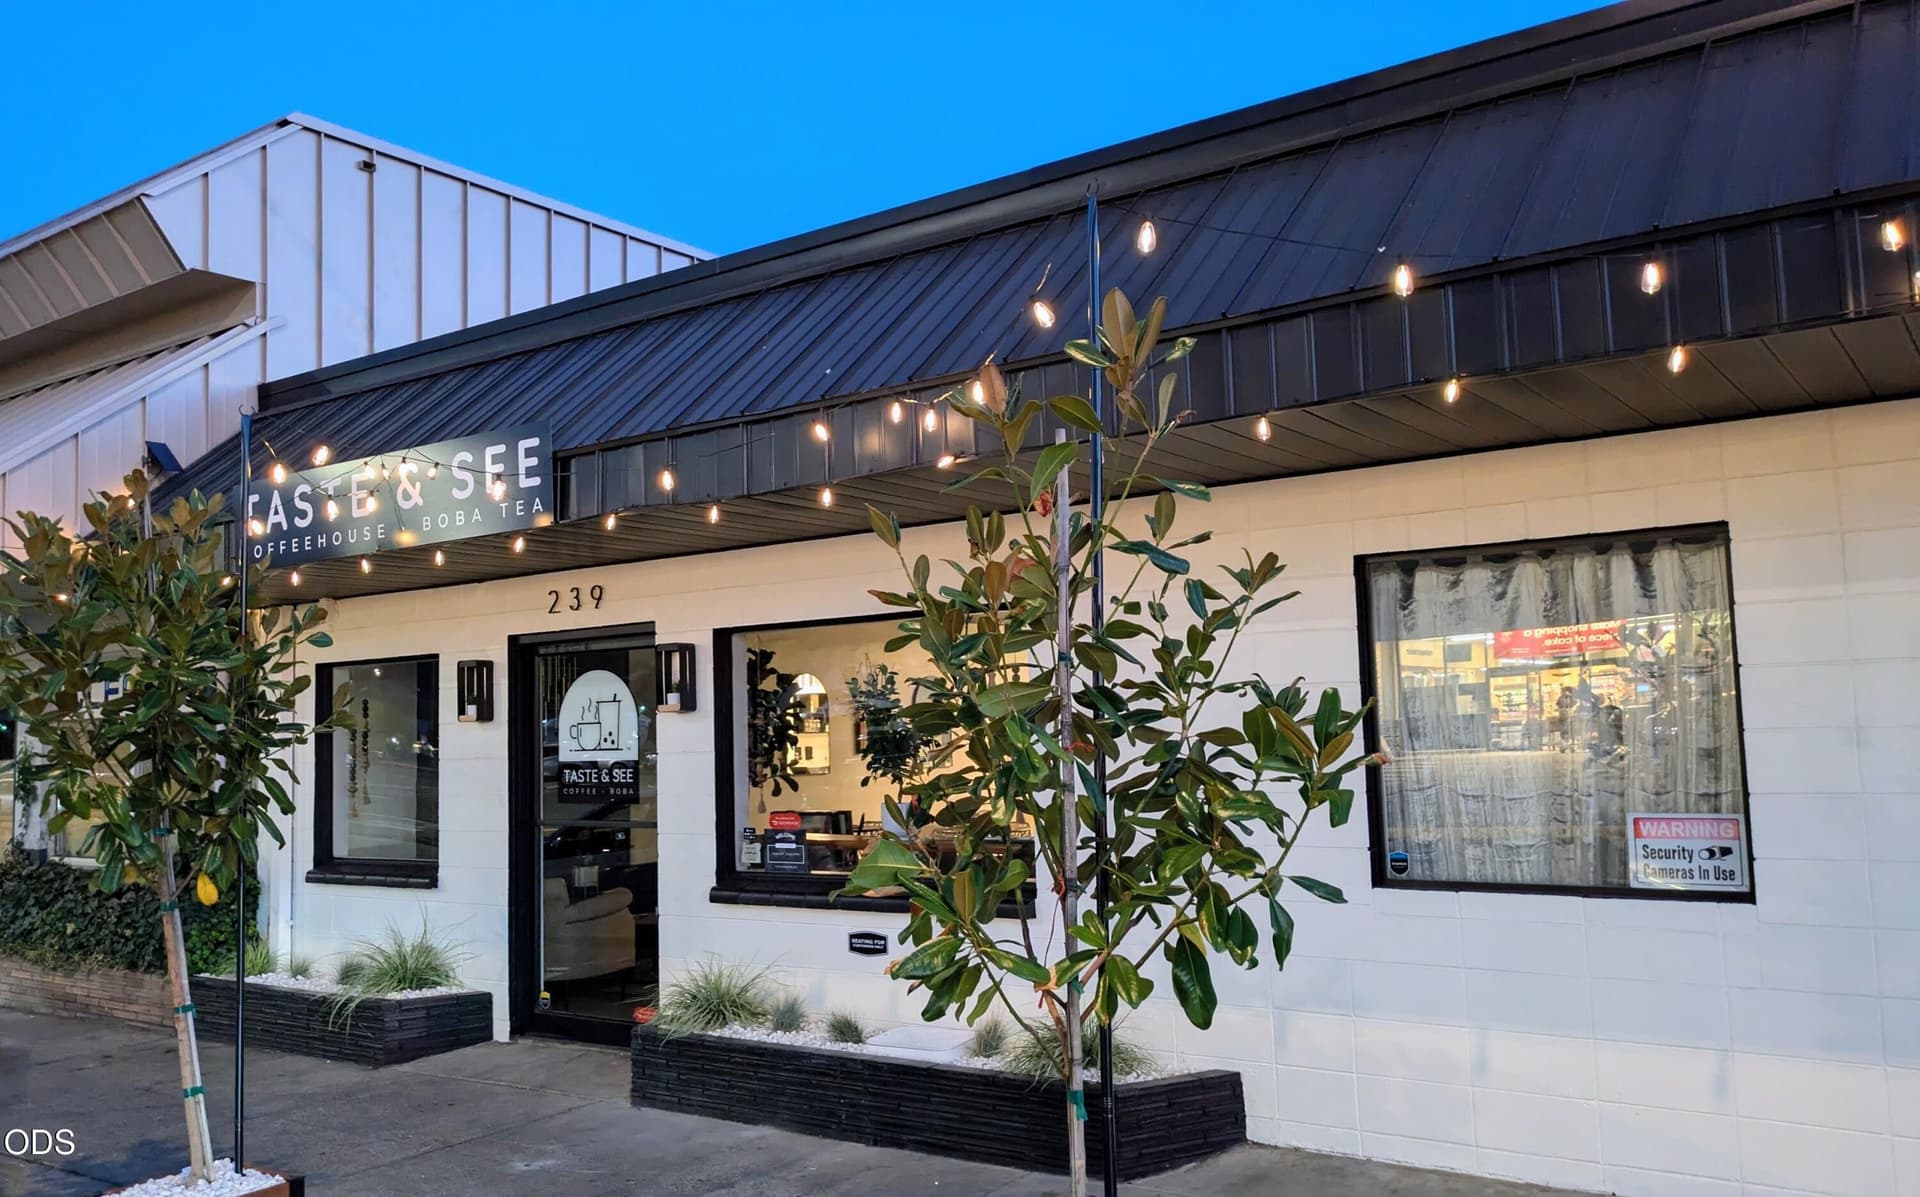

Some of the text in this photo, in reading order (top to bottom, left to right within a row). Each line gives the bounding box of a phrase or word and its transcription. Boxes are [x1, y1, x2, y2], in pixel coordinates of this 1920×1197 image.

[396, 463, 424, 509] &
[451, 437, 541, 500] SEE
[253, 497, 544, 558] OFFEEHOUSE BOBA TEA
[547, 584, 604, 614] 239
[563, 768, 634, 783] TASTE & SEE
[563, 787, 634, 795] COFFEE BOBA
[1639, 821, 1735, 838] WARNING
[1642, 844, 1694, 864] Security
[1643, 863, 1736, 881] Cameras In Use
